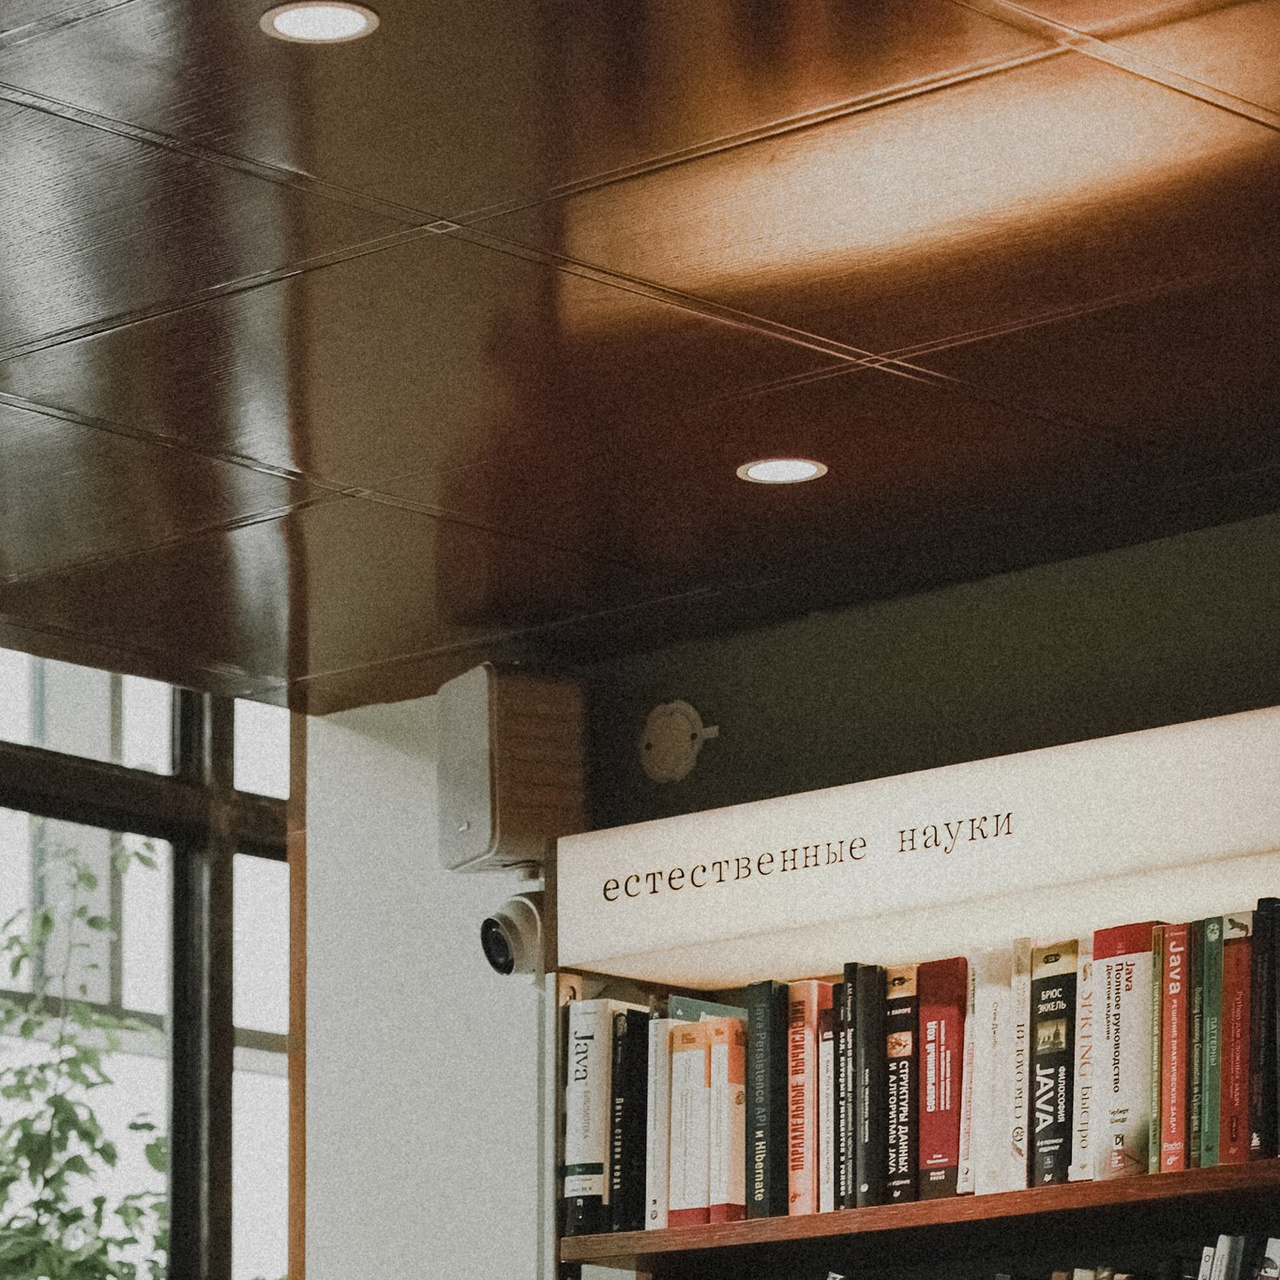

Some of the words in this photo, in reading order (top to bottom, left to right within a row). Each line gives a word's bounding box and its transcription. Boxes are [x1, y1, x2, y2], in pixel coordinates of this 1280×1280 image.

[602, 836, 867, 901] естественные
[898, 811, 1013, 854] науки
[1113, 962, 1123, 1009] Полное
[1124, 961, 1134, 991] Java
[1168, 941, 1183, 994] Java
[1041, 988, 1063, 1000] БРЮС
[1234, 990, 1242, 1019] Python
[926, 1020, 936, 1040] КОД
[1111, 1013, 1122, 1092] руководство
[1209, 1016, 1217, 1066] ПАТТЕРНЫ
[1234, 1022, 1242, 1037] для
[573, 1030, 593, 1082] Java
[755, 1032, 765, 1102] Persistence
[888, 1061, 896, 1070] И
[925, 1043, 936, 1111] СОВЕРШЕННЫЙ
[1233, 1040, 1241, 1078] сложных
[887, 1074, 896, 1143] АЛГОРИТМЫ
[898, 1059, 908, 1122] СТРУКТУРЫ
[1033, 1063, 1055, 1134] JAVA
[1057, 1065, 1066, 1123] ФИЛОСОФИЯ
[1233, 1082, 1241, 1106] задач
[755, 1106, 765, 1126] API
[790, 1082, 804, 1171] ПАРАЛЛЕЛЬНЫЕ
[754, 1141, 765, 1200] Hibernate
[887, 1148, 896, 1174] JAVA
[897, 1125, 907, 1174] ДАННЫХ
